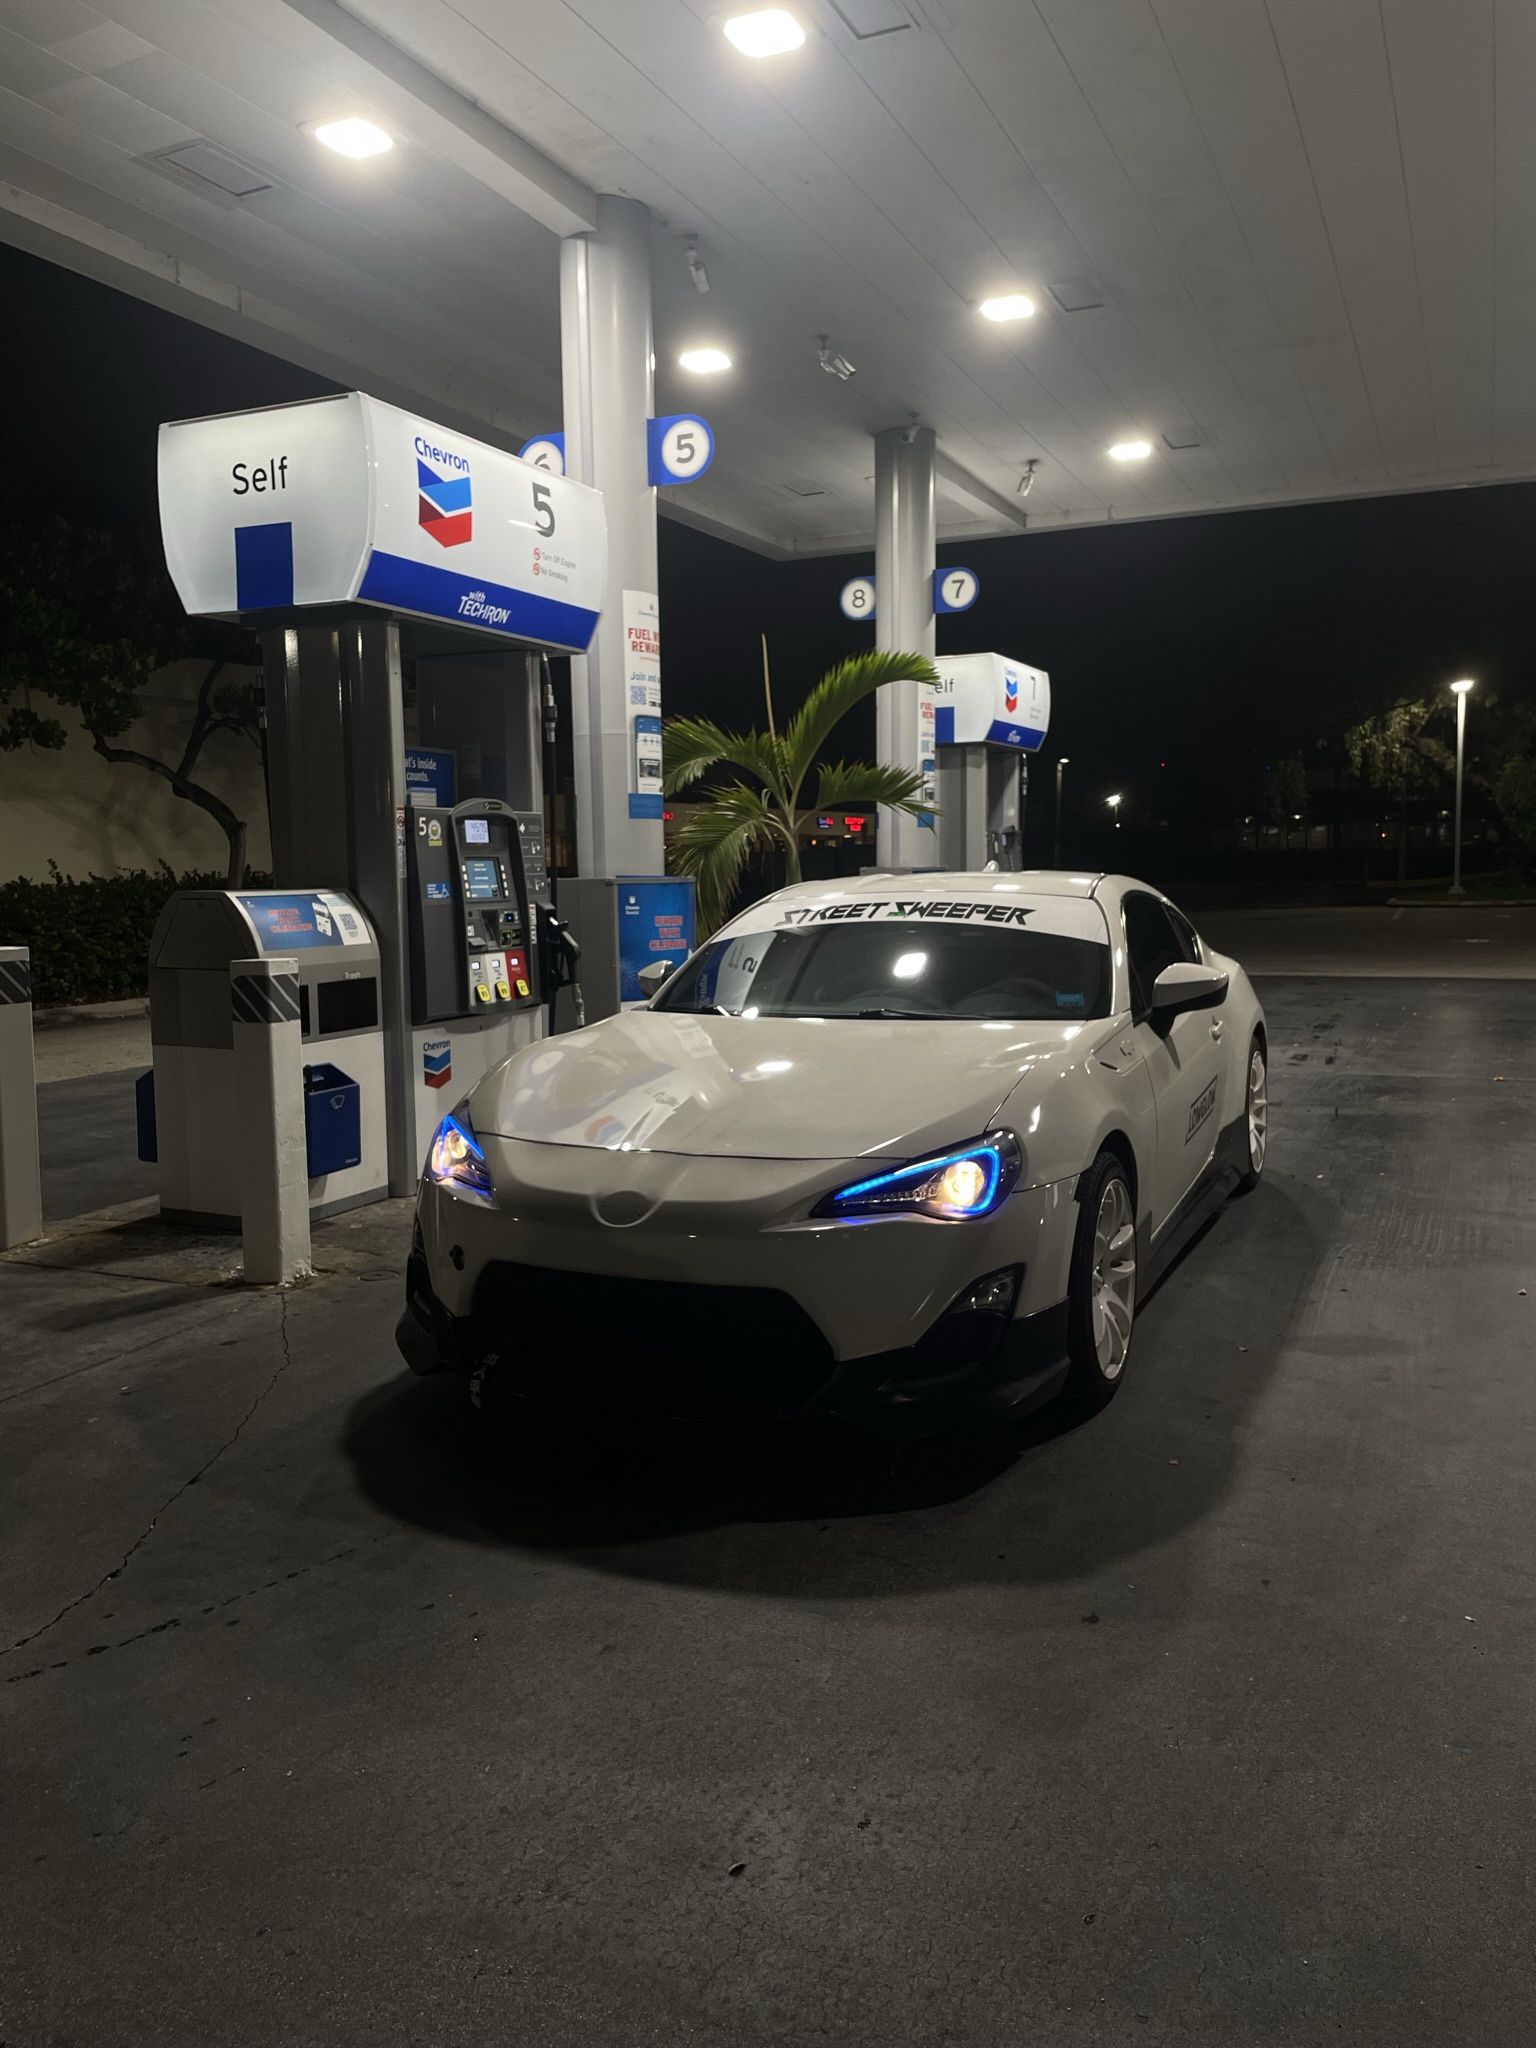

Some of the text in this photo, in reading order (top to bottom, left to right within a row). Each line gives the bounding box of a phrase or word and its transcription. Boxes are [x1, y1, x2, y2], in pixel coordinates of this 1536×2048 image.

[414, 436, 470, 473] Chevron
[676, 432, 695, 464] 5
[232, 455, 288, 495] Self
[532, 482, 555, 538] 5
[469, 591, 486, 603] with
[852, 589, 866, 608] 8
[951, 579, 966, 599] 7
[458, 595, 512, 624] TECHRON
[628, 627, 651, 641] FUEL
[935, 678, 954, 694] elf
[417, 758, 437, 770] inside
[406, 771, 430, 782] counts.
[418, 816, 428, 836] 5
[775, 901, 1037, 926] STREET SWEEPER
[422, 1039, 451, 1052] Chevron
